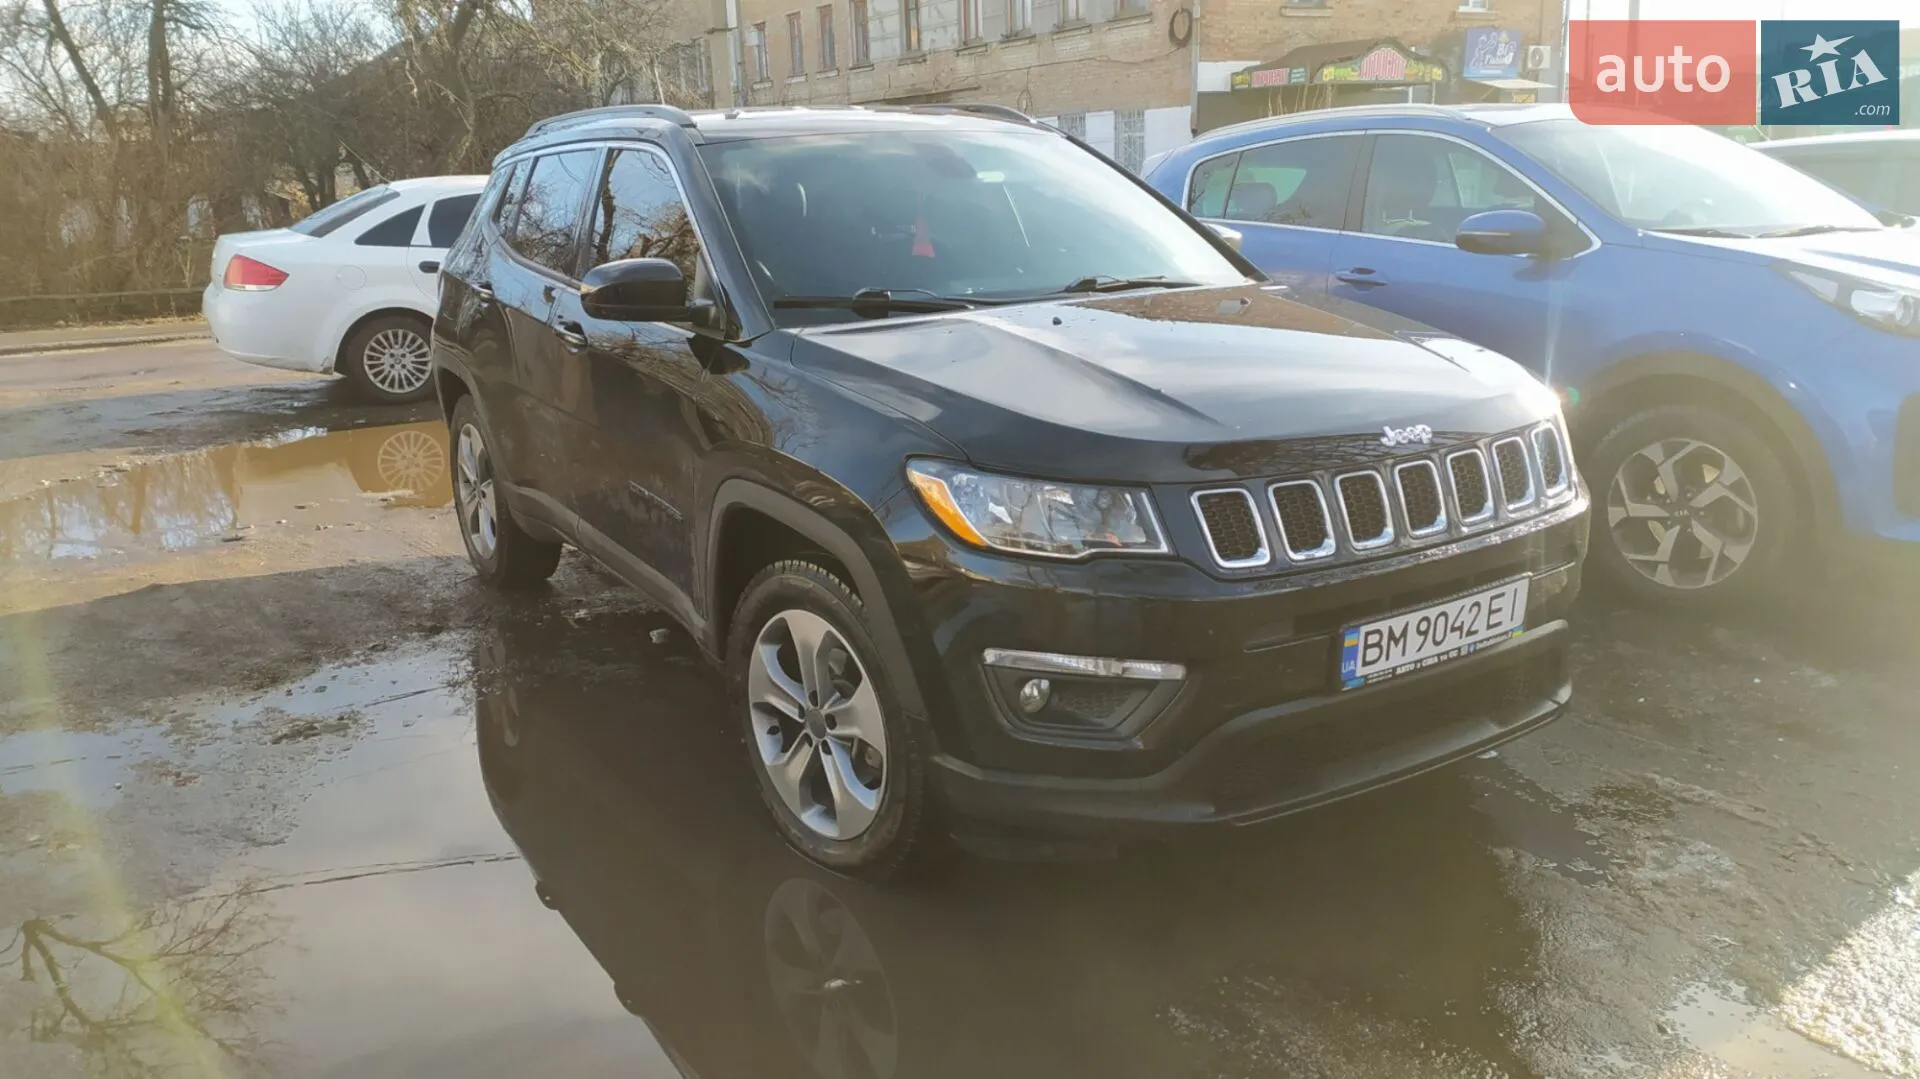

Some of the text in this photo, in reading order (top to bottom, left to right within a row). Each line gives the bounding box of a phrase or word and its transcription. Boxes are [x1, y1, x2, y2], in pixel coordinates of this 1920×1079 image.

[1380, 424, 1433, 447] Jeep
[1361, 620, 1410, 668] BM
[1415, 600, 1482, 653] 9042
[1341, 661, 1356, 673] UA
